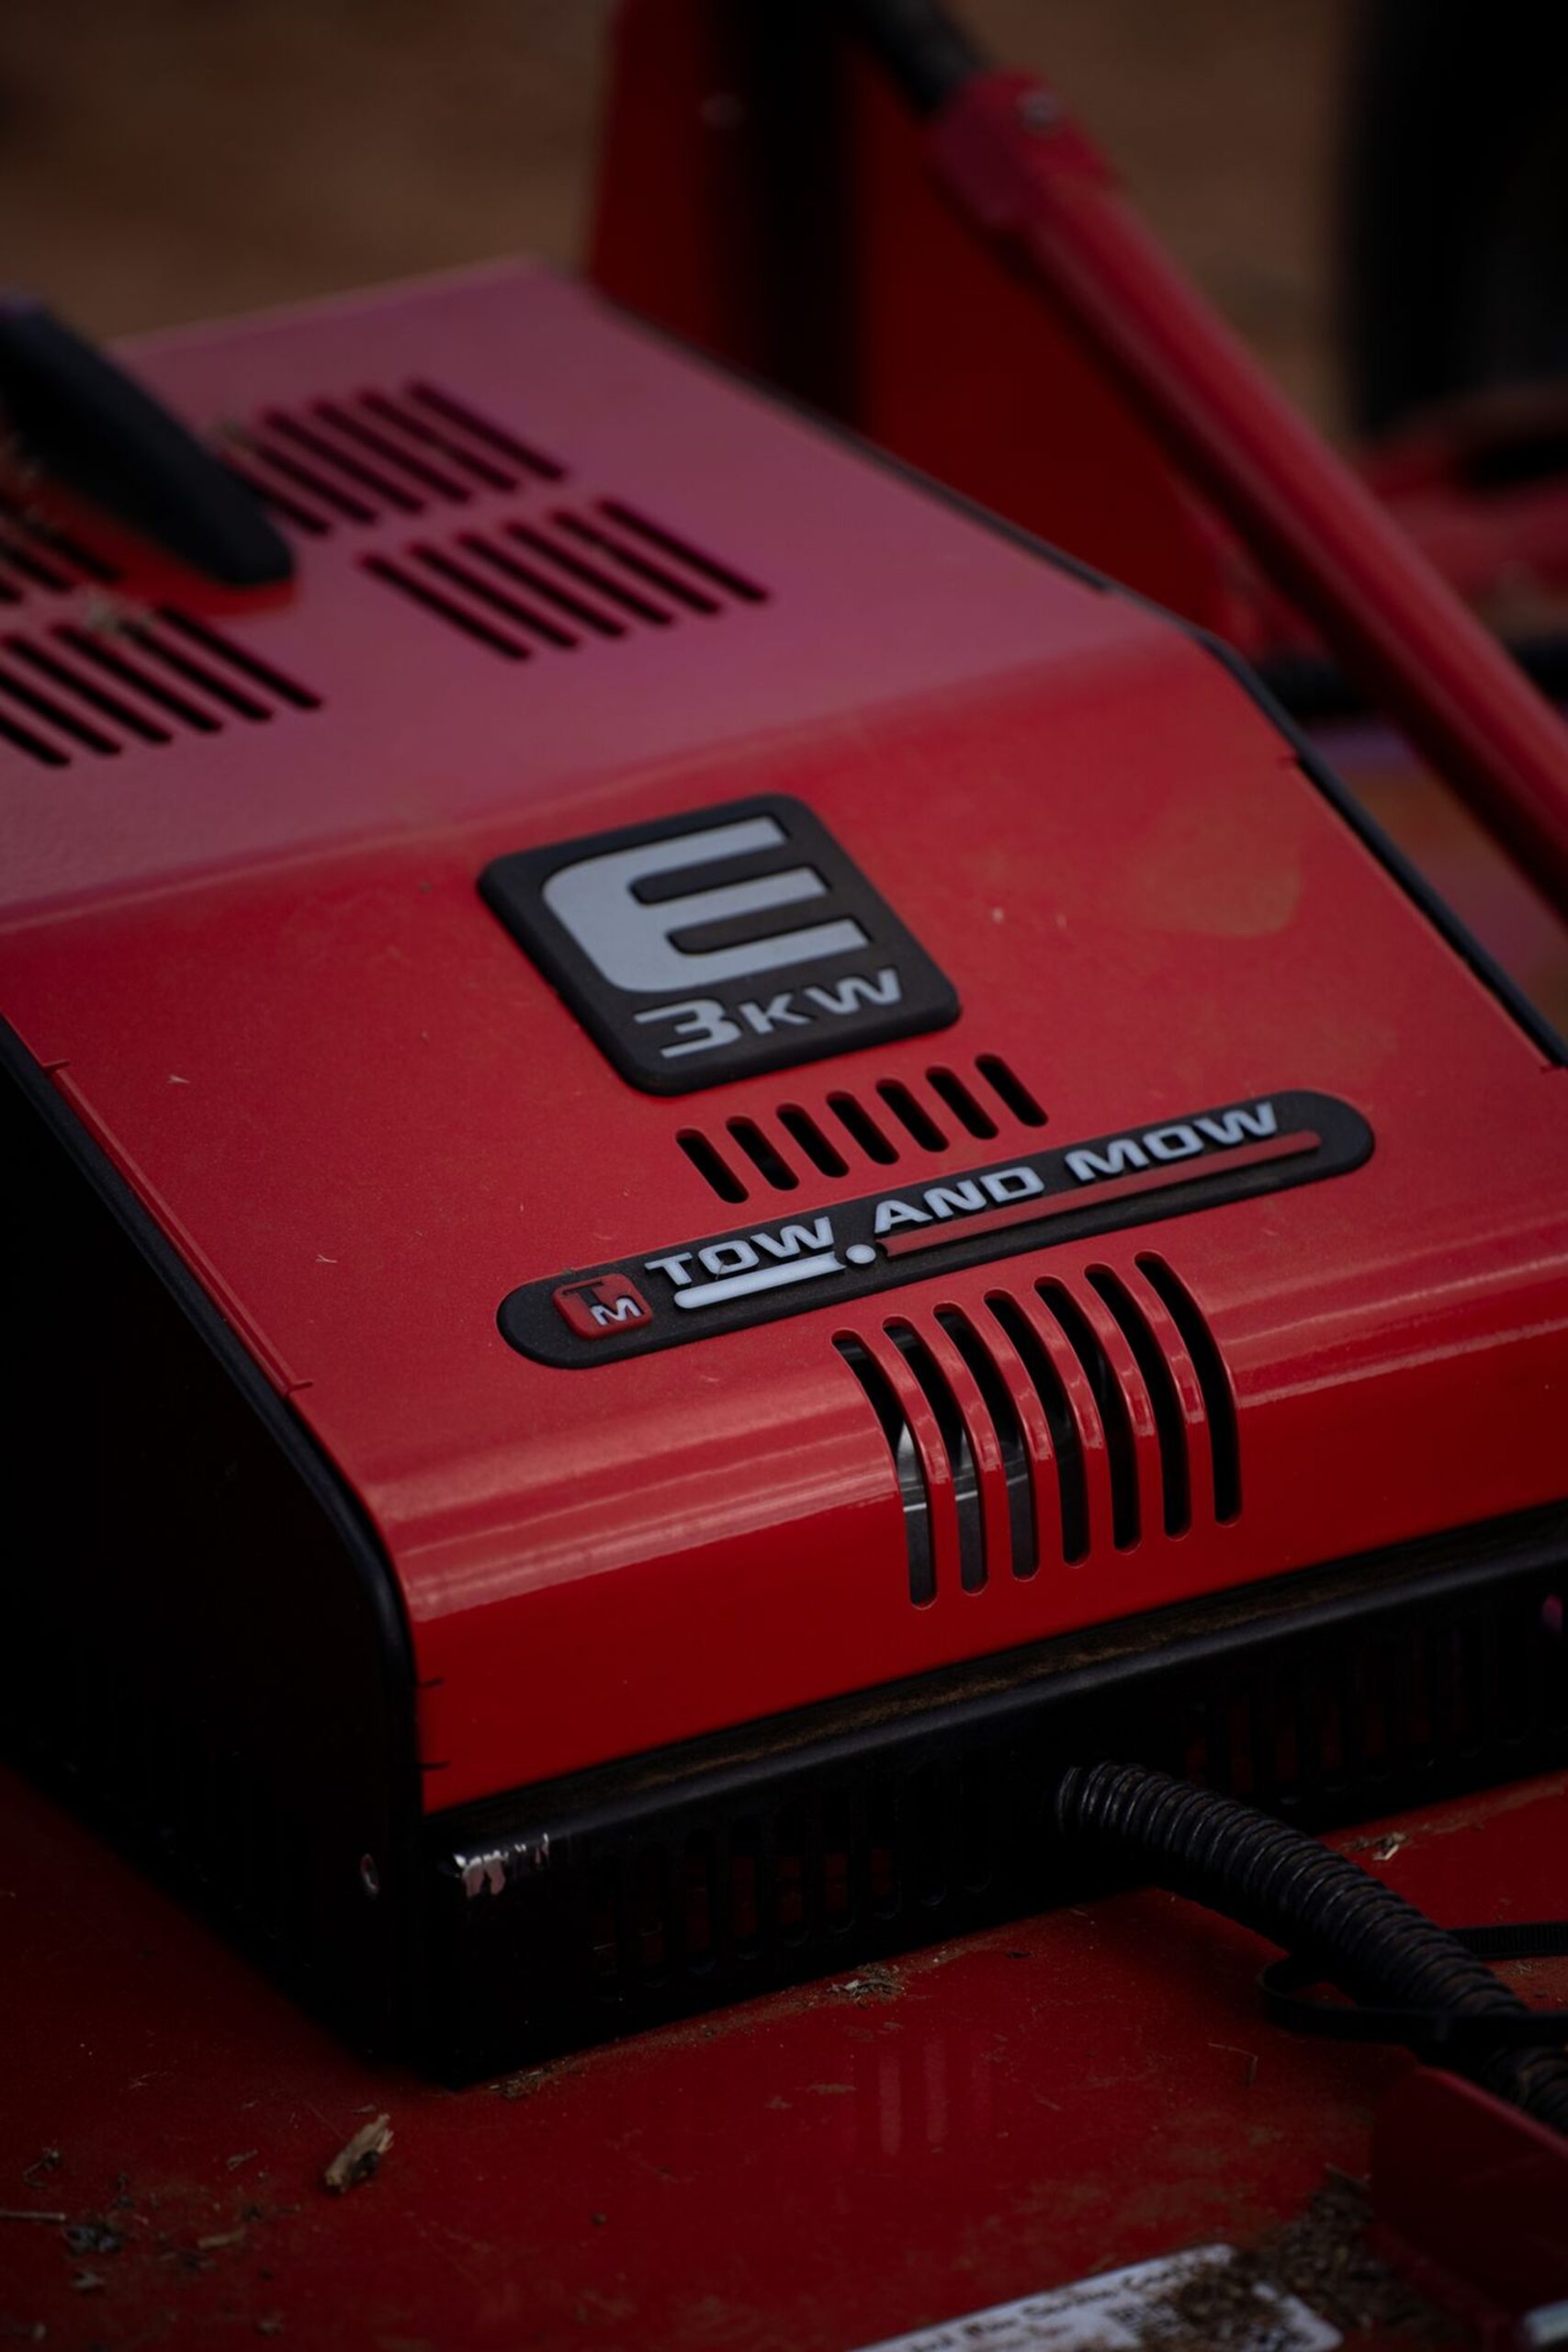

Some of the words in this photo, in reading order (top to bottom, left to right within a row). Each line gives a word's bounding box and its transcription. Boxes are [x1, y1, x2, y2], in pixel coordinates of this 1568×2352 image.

[542, 816, 871, 992] E
[634, 968, 901, 1058] 3KW
[644, 1216, 835, 1285] TOW
[874, 1166, 1044, 1234] AND
[1064, 1102, 1277, 1182] MOW
